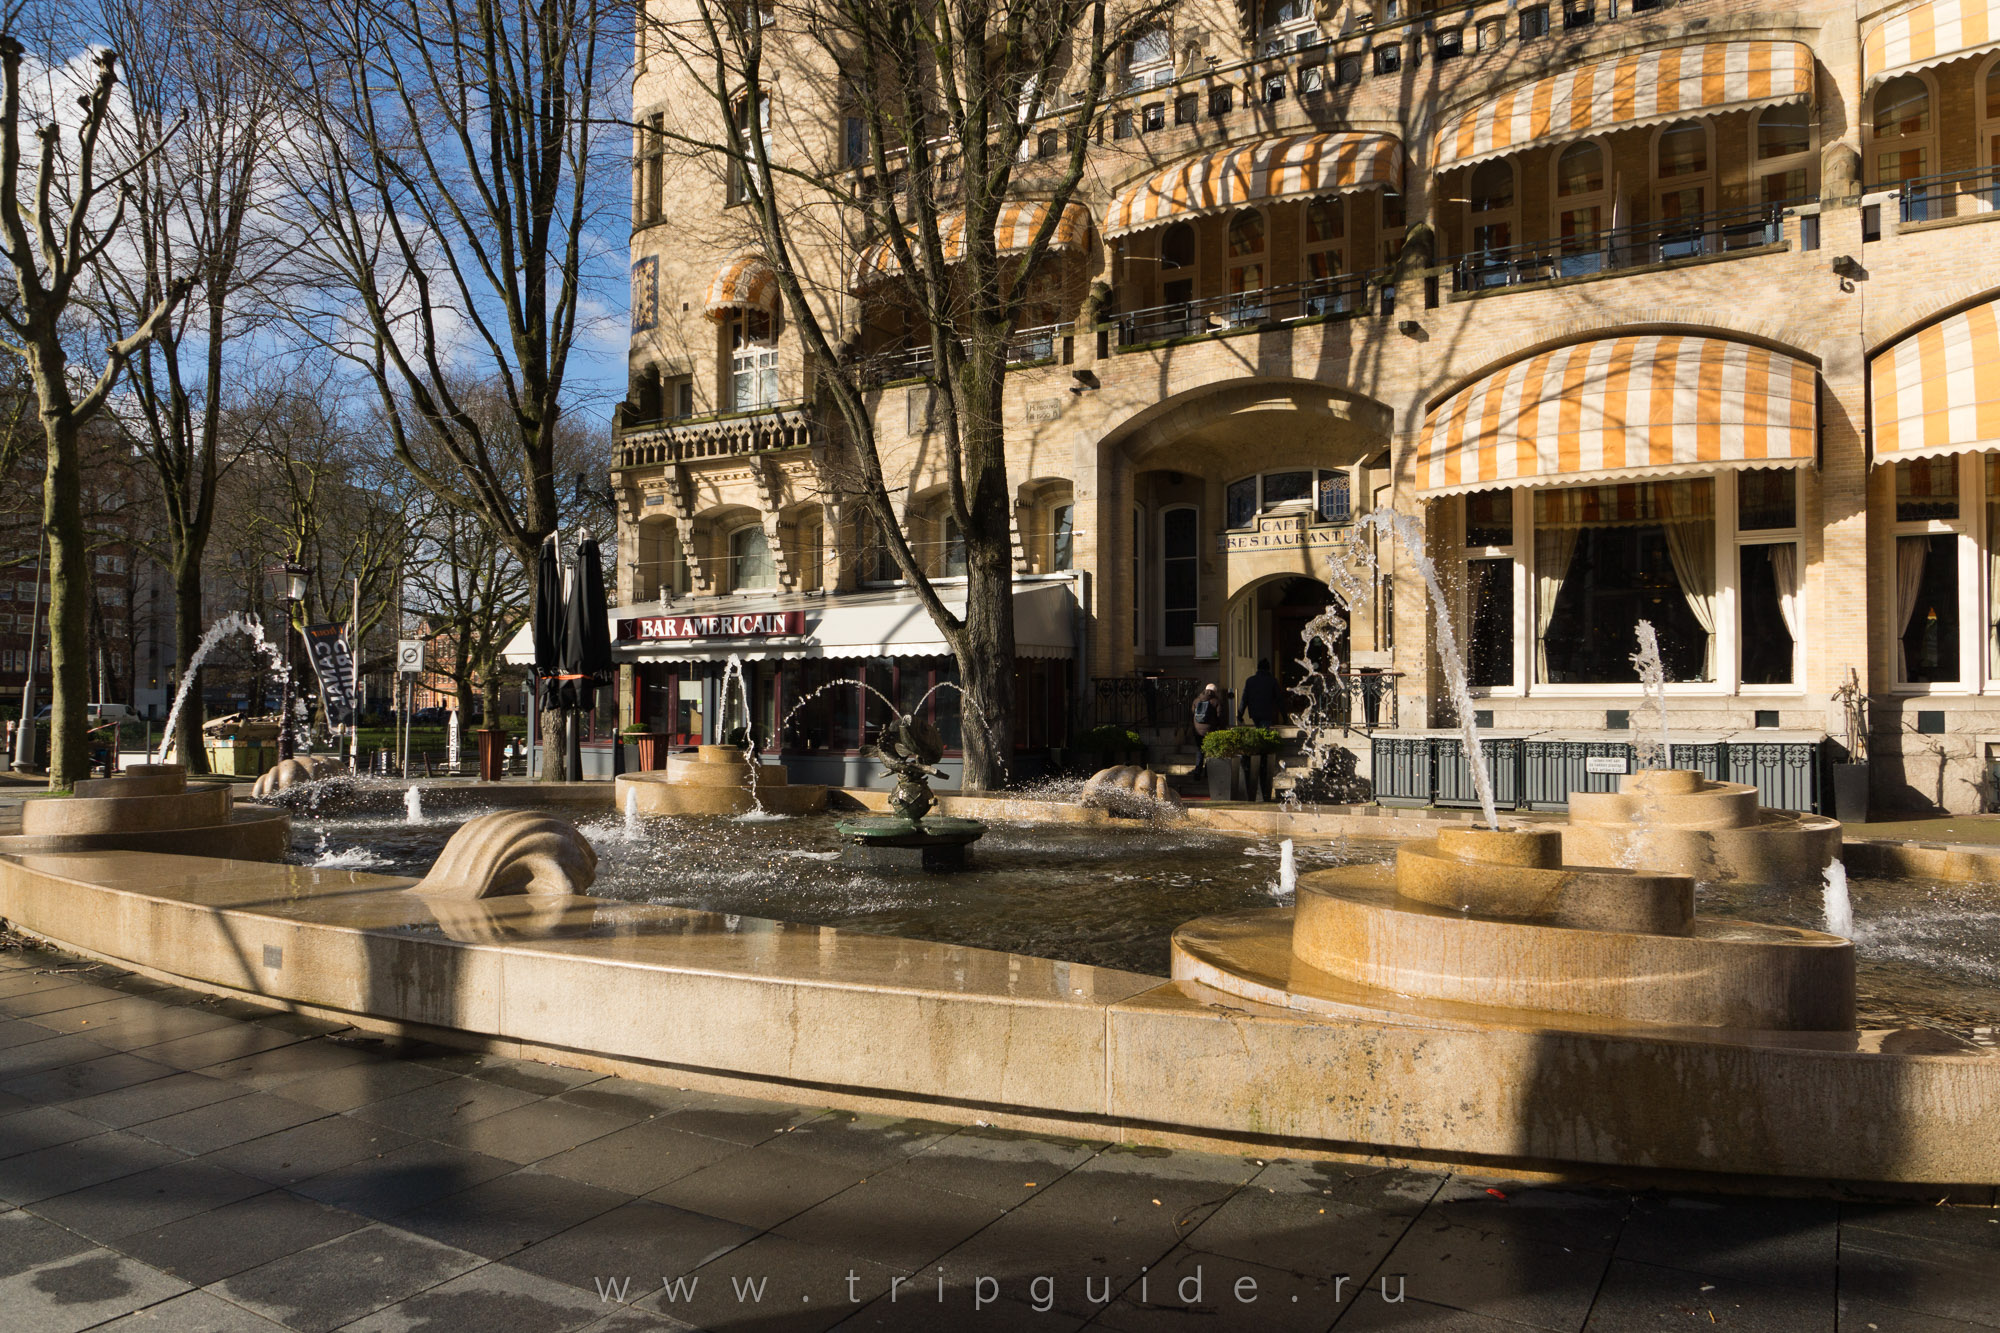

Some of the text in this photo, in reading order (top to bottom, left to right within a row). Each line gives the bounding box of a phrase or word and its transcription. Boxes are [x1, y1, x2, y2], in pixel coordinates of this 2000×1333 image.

[1226, 531, 1342, 549] RESTAURANT
[640, 614, 787, 638] BAR AMERICAIN
